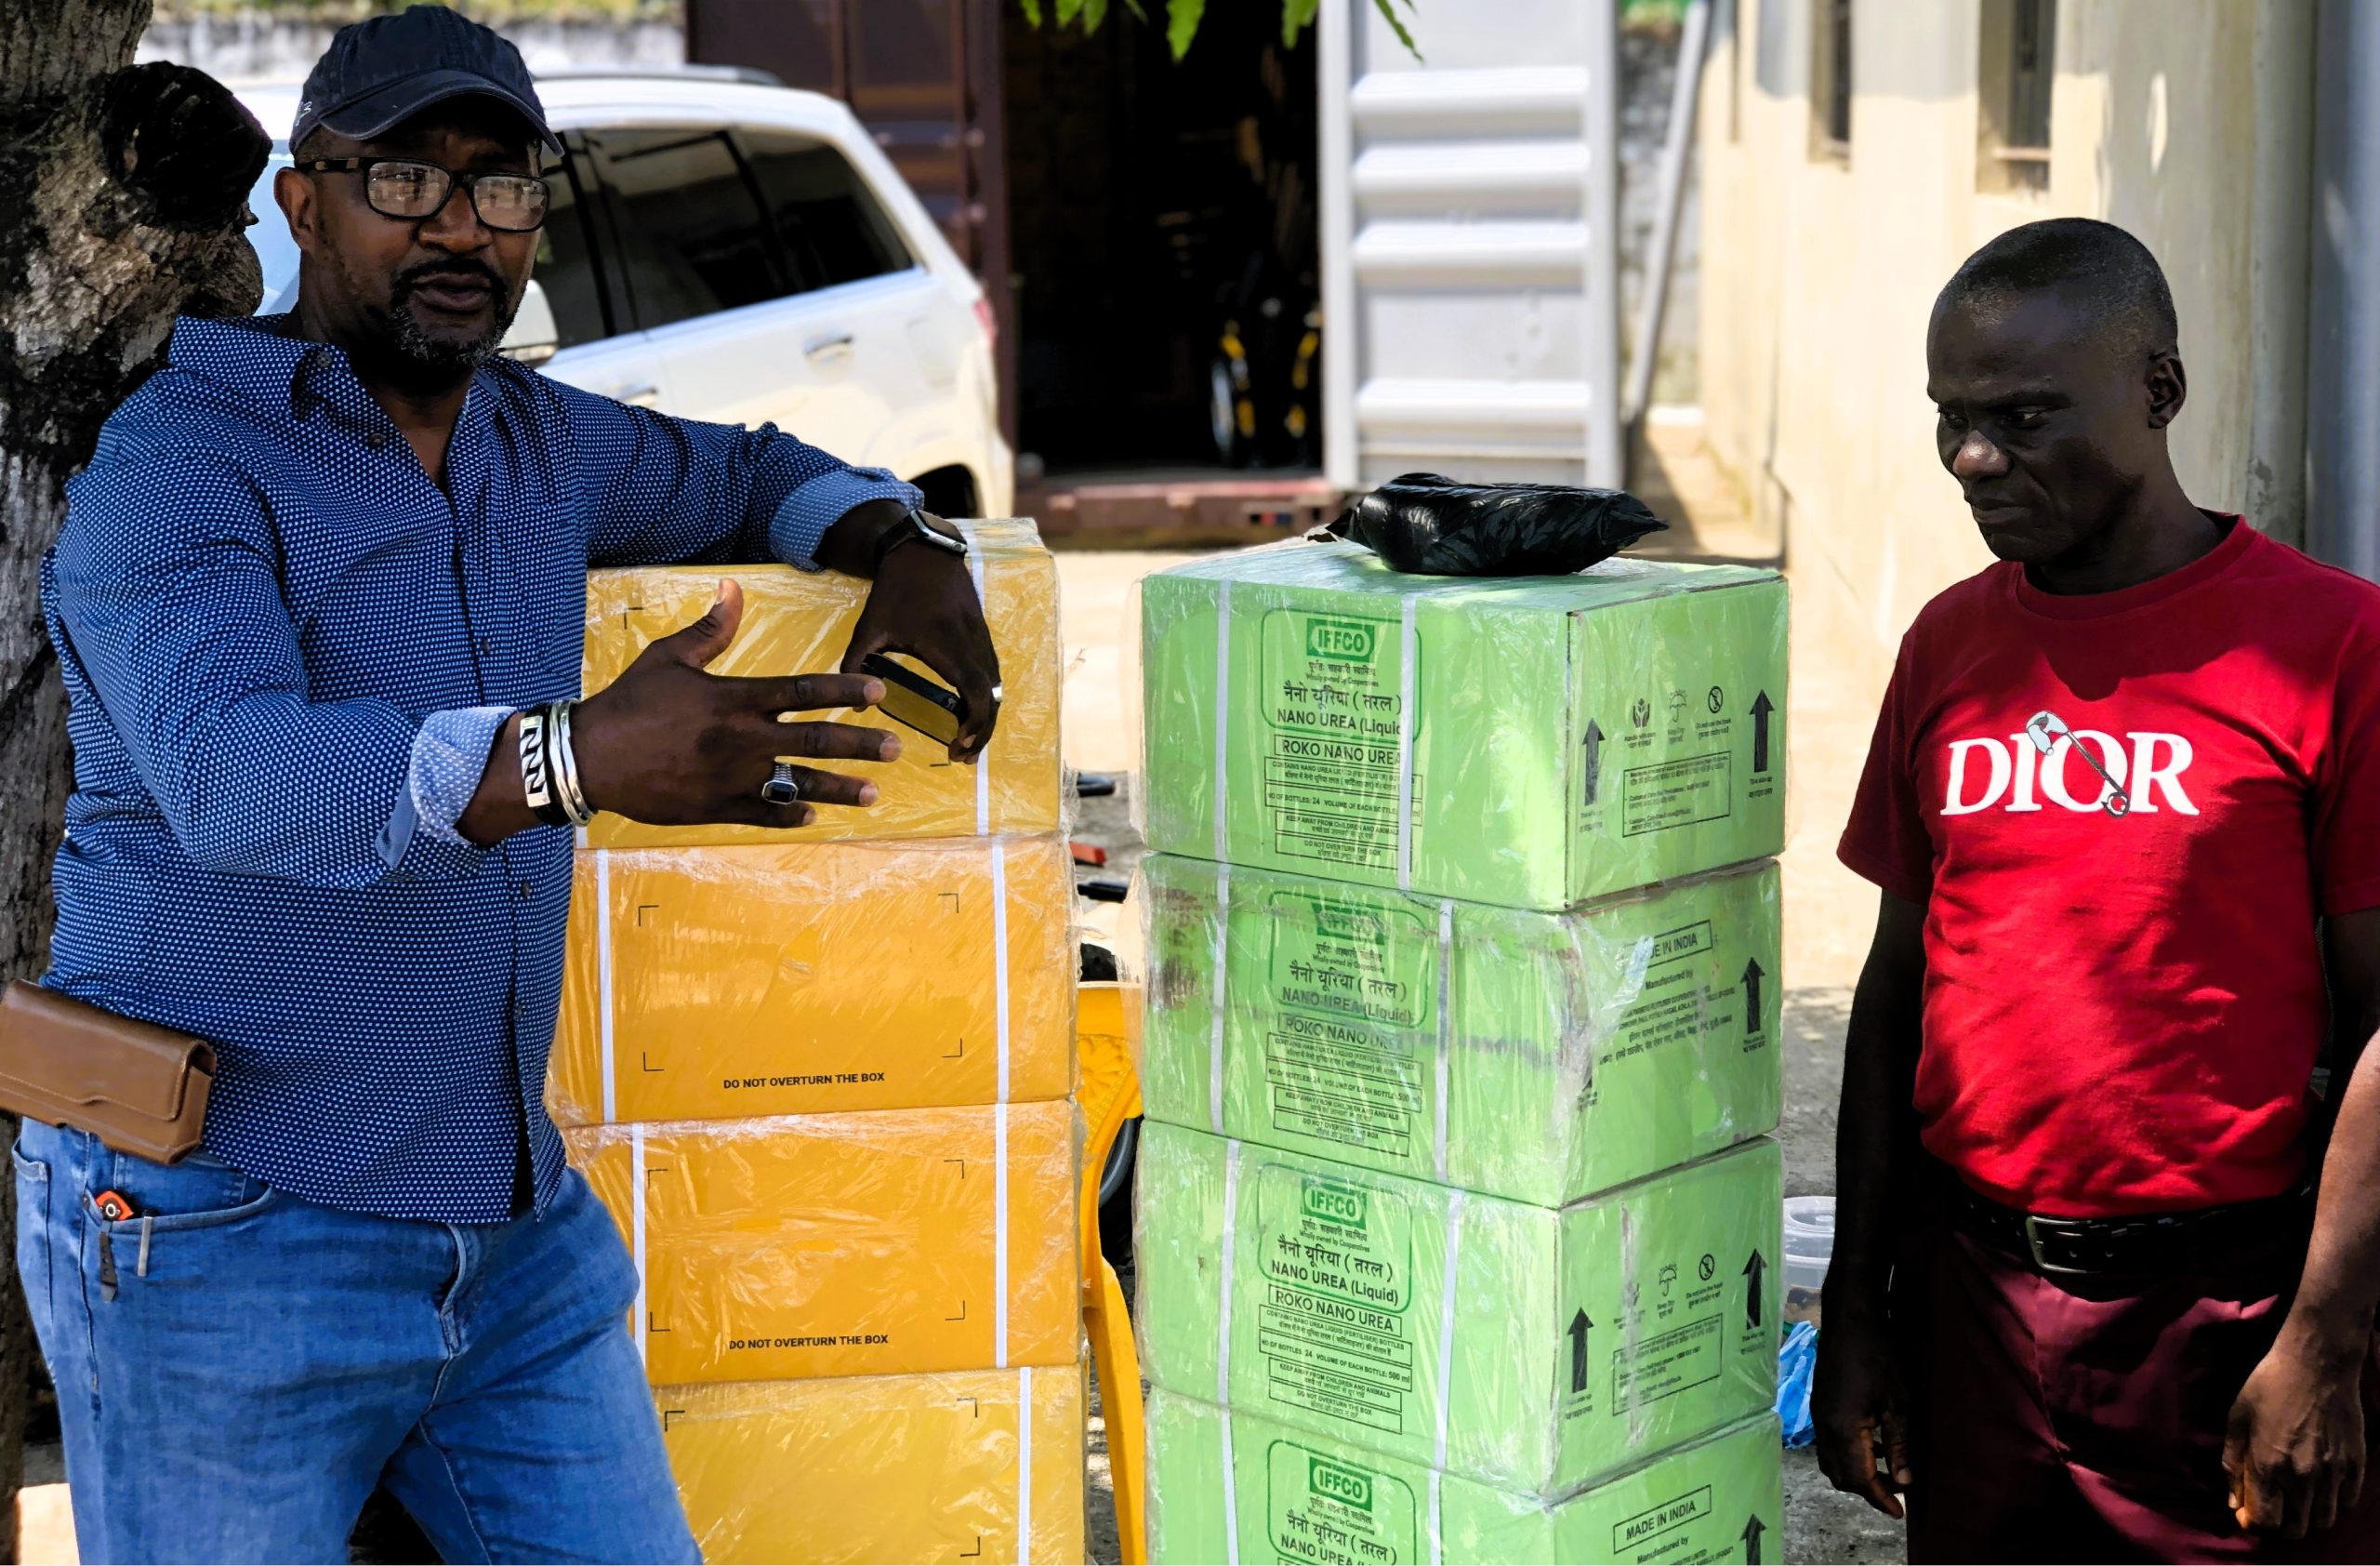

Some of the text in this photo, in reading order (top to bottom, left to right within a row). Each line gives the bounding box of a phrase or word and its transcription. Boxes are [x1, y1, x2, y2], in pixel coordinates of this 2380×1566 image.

[1318, 629, 1365, 652] IFFCO
[1283, 680, 1308, 703] नैनो
[1312, 684, 1350, 710] यूरिया
[1362, 695, 1393, 711] तरल
[1277, 708, 1316, 725] NANO
[1319, 713, 1356, 729] UREA
[1283, 739, 1320, 756] ROKO
[1324, 744, 1364, 761] NANO
[1940, 729, 2201, 816] DIOR
[1324, 800, 1347, 808] VOLUME
[1326, 844, 1355, 853] OVERTURN
[1673, 933, 1698, 952] INDIA
[1289, 960, 1314, 983] नैनो
[1317, 966, 1355, 992] यूरिया
[1368, 978, 1397, 999] तरल
[1282, 987, 1319, 1005] NANO
[1365, 1002, 1411, 1024] (Liquid)
[1287, 1017, 1324, 1036] ROKO
[1327, 1025, 1367, 1045] NANO
[723, 1072, 885, 1089] DO NOT OVERTURN THE BOX
[1398, 1093, 1409, 1103] 500
[1310, 1190, 1355, 1217] IFFCO
[1277, 1233, 1301, 1257] नैनो
[1304, 1243, 1341, 1268] यूरिया
[1354, 1257, 1383, 1278] तरल
[1272, 1260, 1398, 1307] NANO UREA (Liquid)
[1276, 1290, 1394, 1332] ROKO NANO UREA
[729, 1334, 888, 1349] DO NOT OVERTURN THE BOX
[1294, 1316, 1309, 1325] NANO
[1310, 1320, 1324, 1328] UREA
[1325, 1323, 1343, 1334] LIQUID
[1379, 1338, 1405, 1350] BOTTLES
[1304, 1348, 1313, 1358] 24
[1316, 1354, 1339, 1365] VOLUME
[1348, 1362, 1364, 1373] EACH
[1364, 1366, 1388, 1377] BOTTLE:
[1389, 1371, 1400, 1382] 500
[1279, 1363, 1293, 1373] KEEP
[1310, 1371, 1325, 1380] FROM
[1326, 1374, 1353, 1387] CHILDREN
[1354, 1382, 1366, 1391] AND
[1367, 1386, 1390, 1399] ANIMALS
[1318, 1396, 1347, 1409] OVERTURN
[1360, 1406, 1372, 1415] BOX
[1319, 1470, 1363, 1499] IFFCO
[1626, 1500, 1696, 1540] MADE IN INDIA
[1281, 1533, 1316, 1557] NANO
[1287, 1508, 1309, 1534] नैनो
[1313, 1521, 1348, 1546] यूरिया
[1359, 1539, 1388, 1562] तरल
[1637, 1539, 1680, 1564] Manufactured
[1681, 1536, 1689, 1546] by
